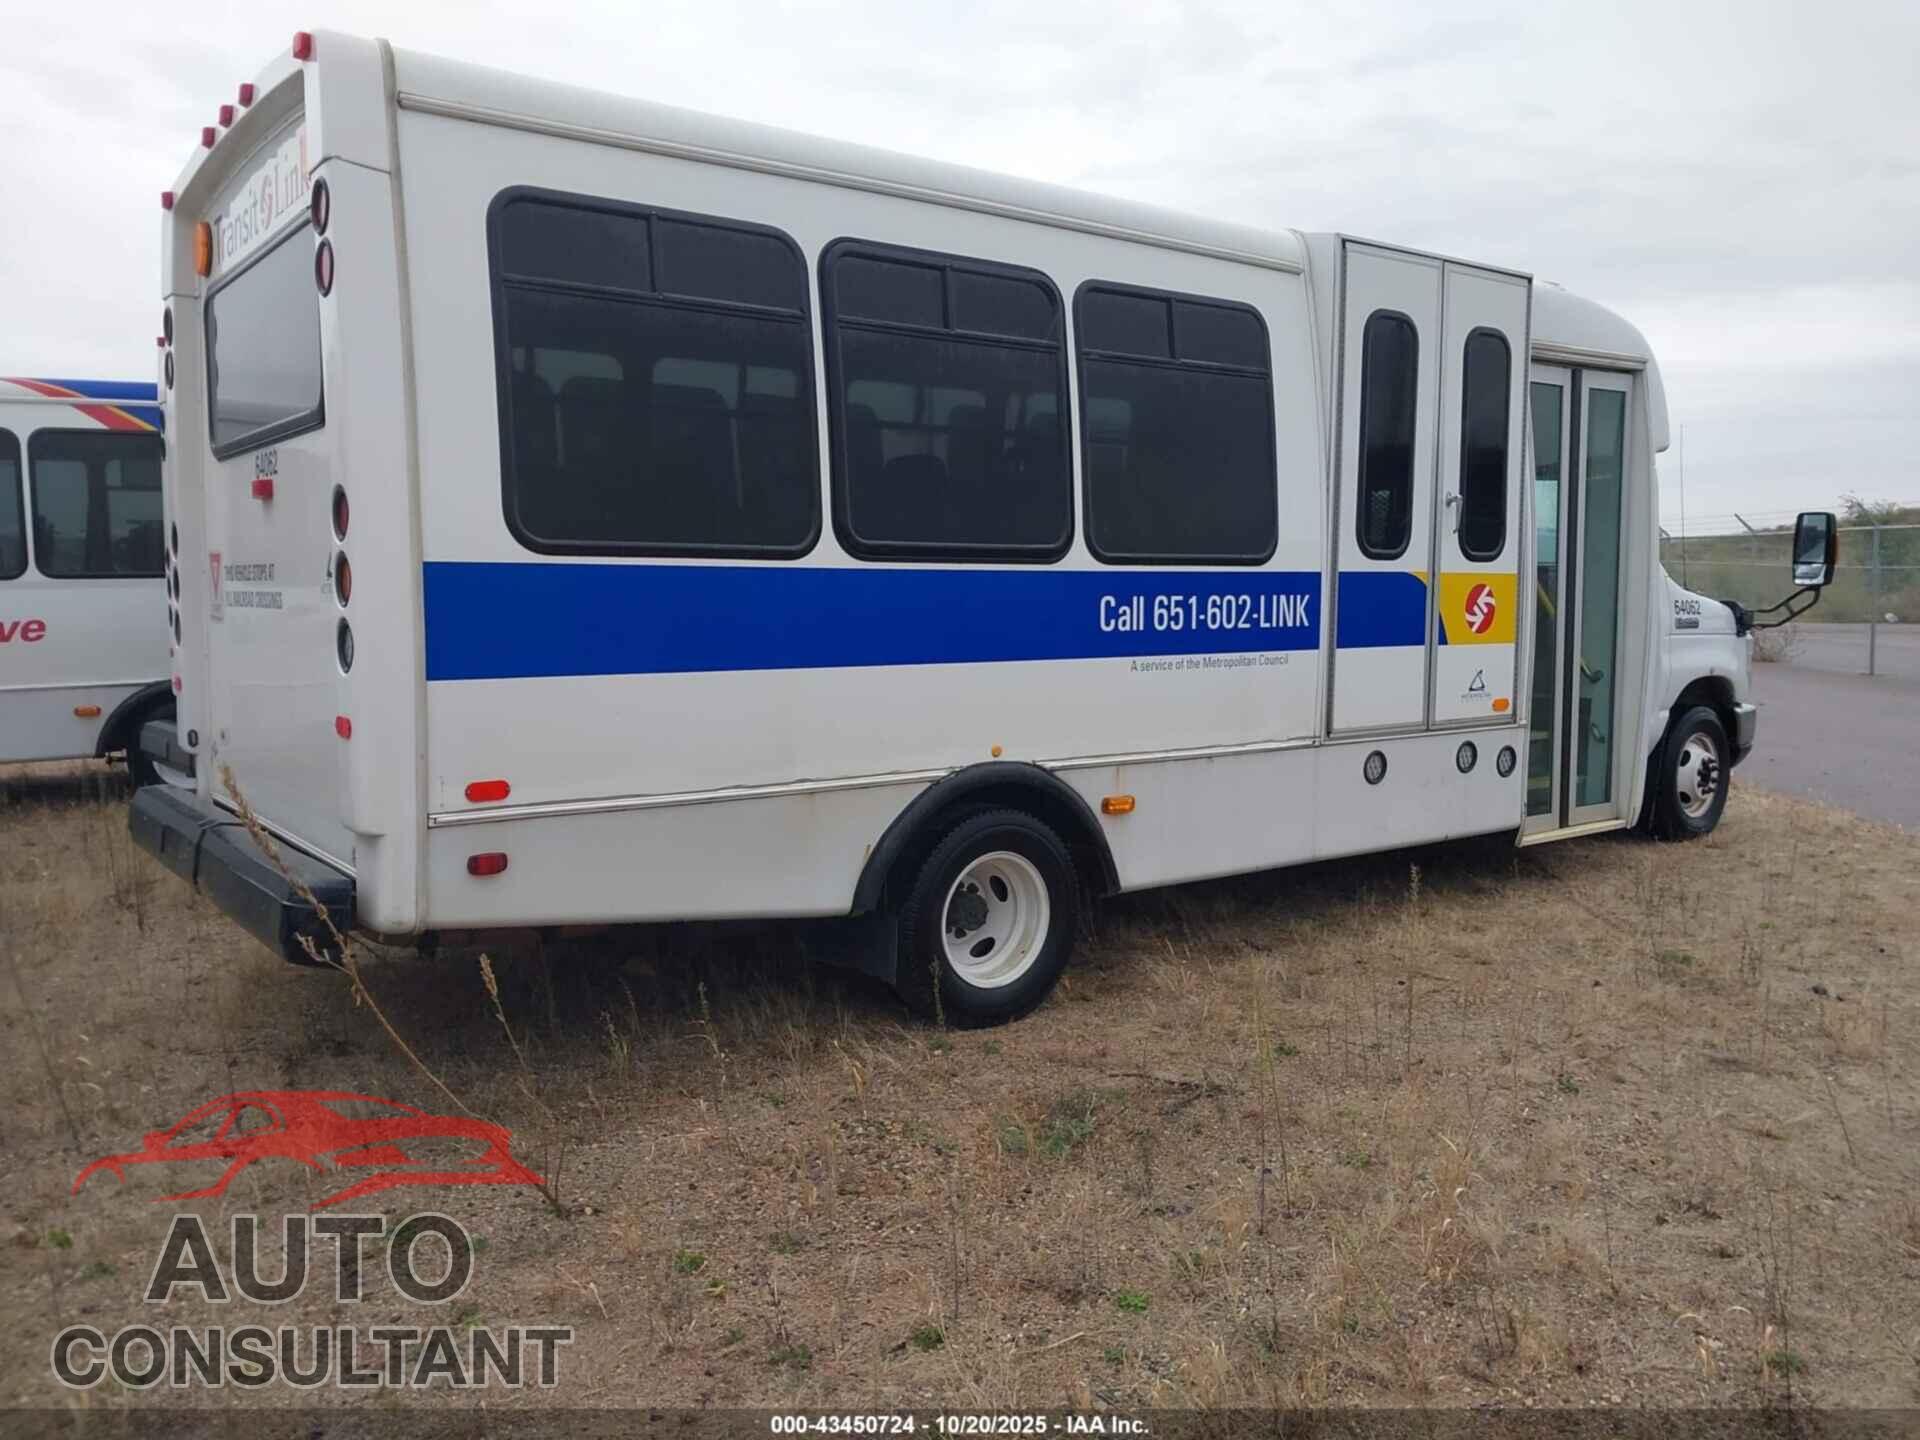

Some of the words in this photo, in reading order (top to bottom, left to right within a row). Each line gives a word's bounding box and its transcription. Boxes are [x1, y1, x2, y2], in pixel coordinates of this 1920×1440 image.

[213, 185, 259, 265] Transit
[255, 448, 279, 479] 64062
[1100, 595, 1145, 631] Call
[1153, 594, 1310, 631] 651-602-LINK
[1673, 599, 1701, 616] 64062
[1130, 660, 1139, 671] A
[1140, 660, 1173, 672] service
[1175, 659, 1185, 670] of
[1186, 658, 1200, 669] the
[1202, 655, 1257, 670] Metropolitan
[1258, 653, 1289, 666] Council
